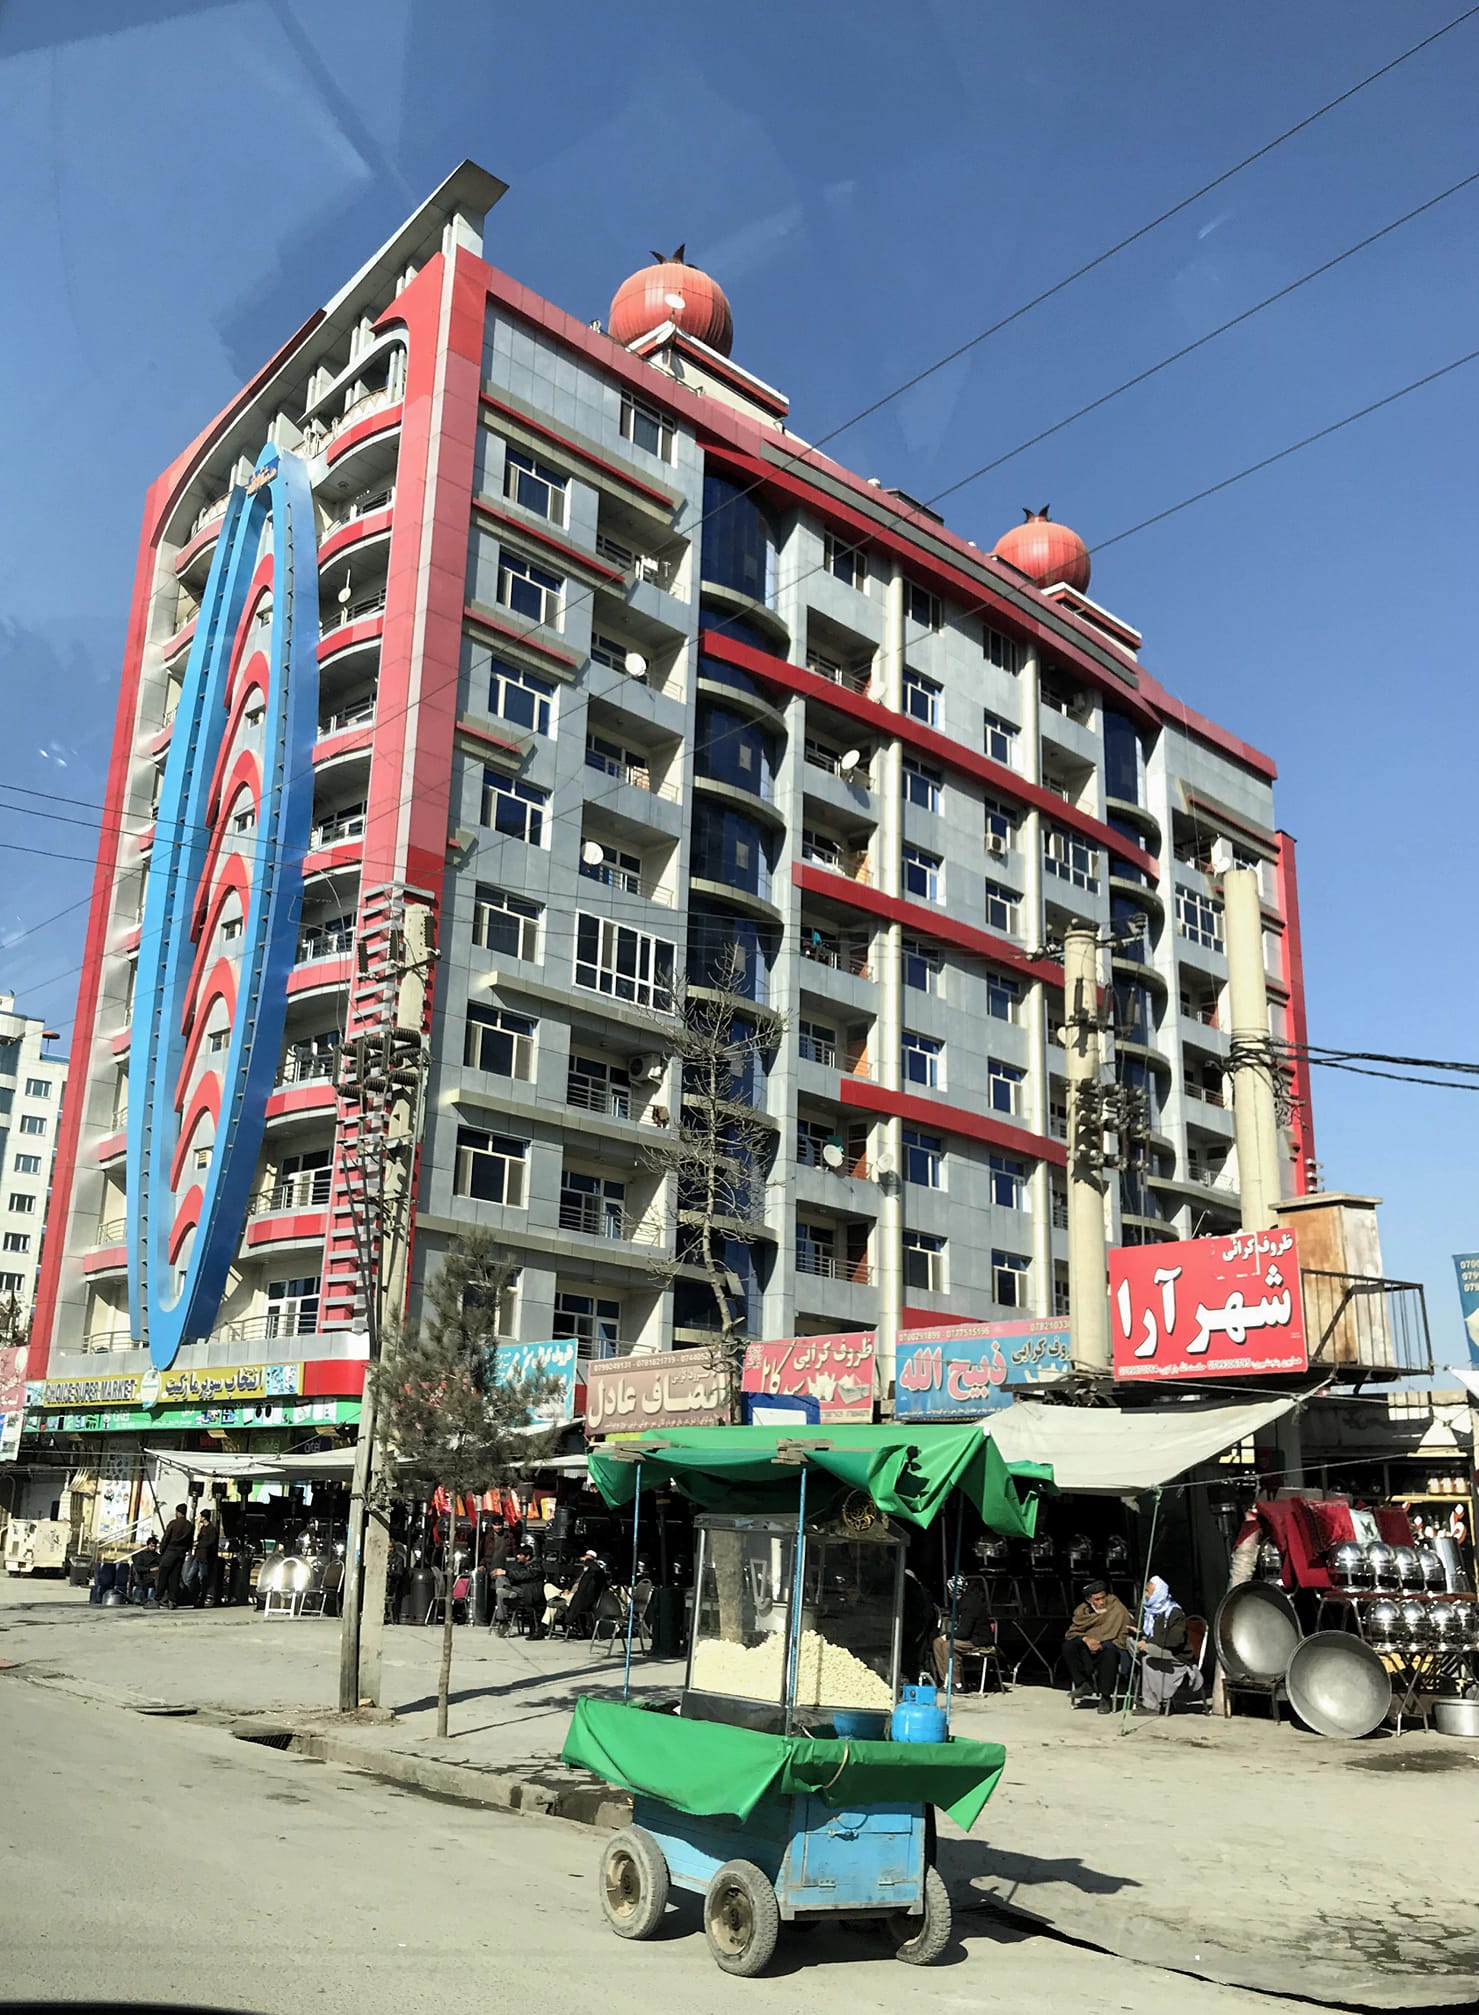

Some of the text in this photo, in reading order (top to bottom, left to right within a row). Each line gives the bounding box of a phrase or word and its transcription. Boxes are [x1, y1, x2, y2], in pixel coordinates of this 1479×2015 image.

[1257, 1232, 1293, 1256] ظروف
[1117, 1264, 1292, 1357] شهر آرا
[833, 1336, 873, 1367] ظروف
[225, 1367, 263, 1399] انتخاب
[899, 1340, 1008, 1400] ذبیح الله
[47, 1379, 136, 1402] CHOICE SUPER MARKET
[588, 1373, 727, 1428] انصاف عادل
